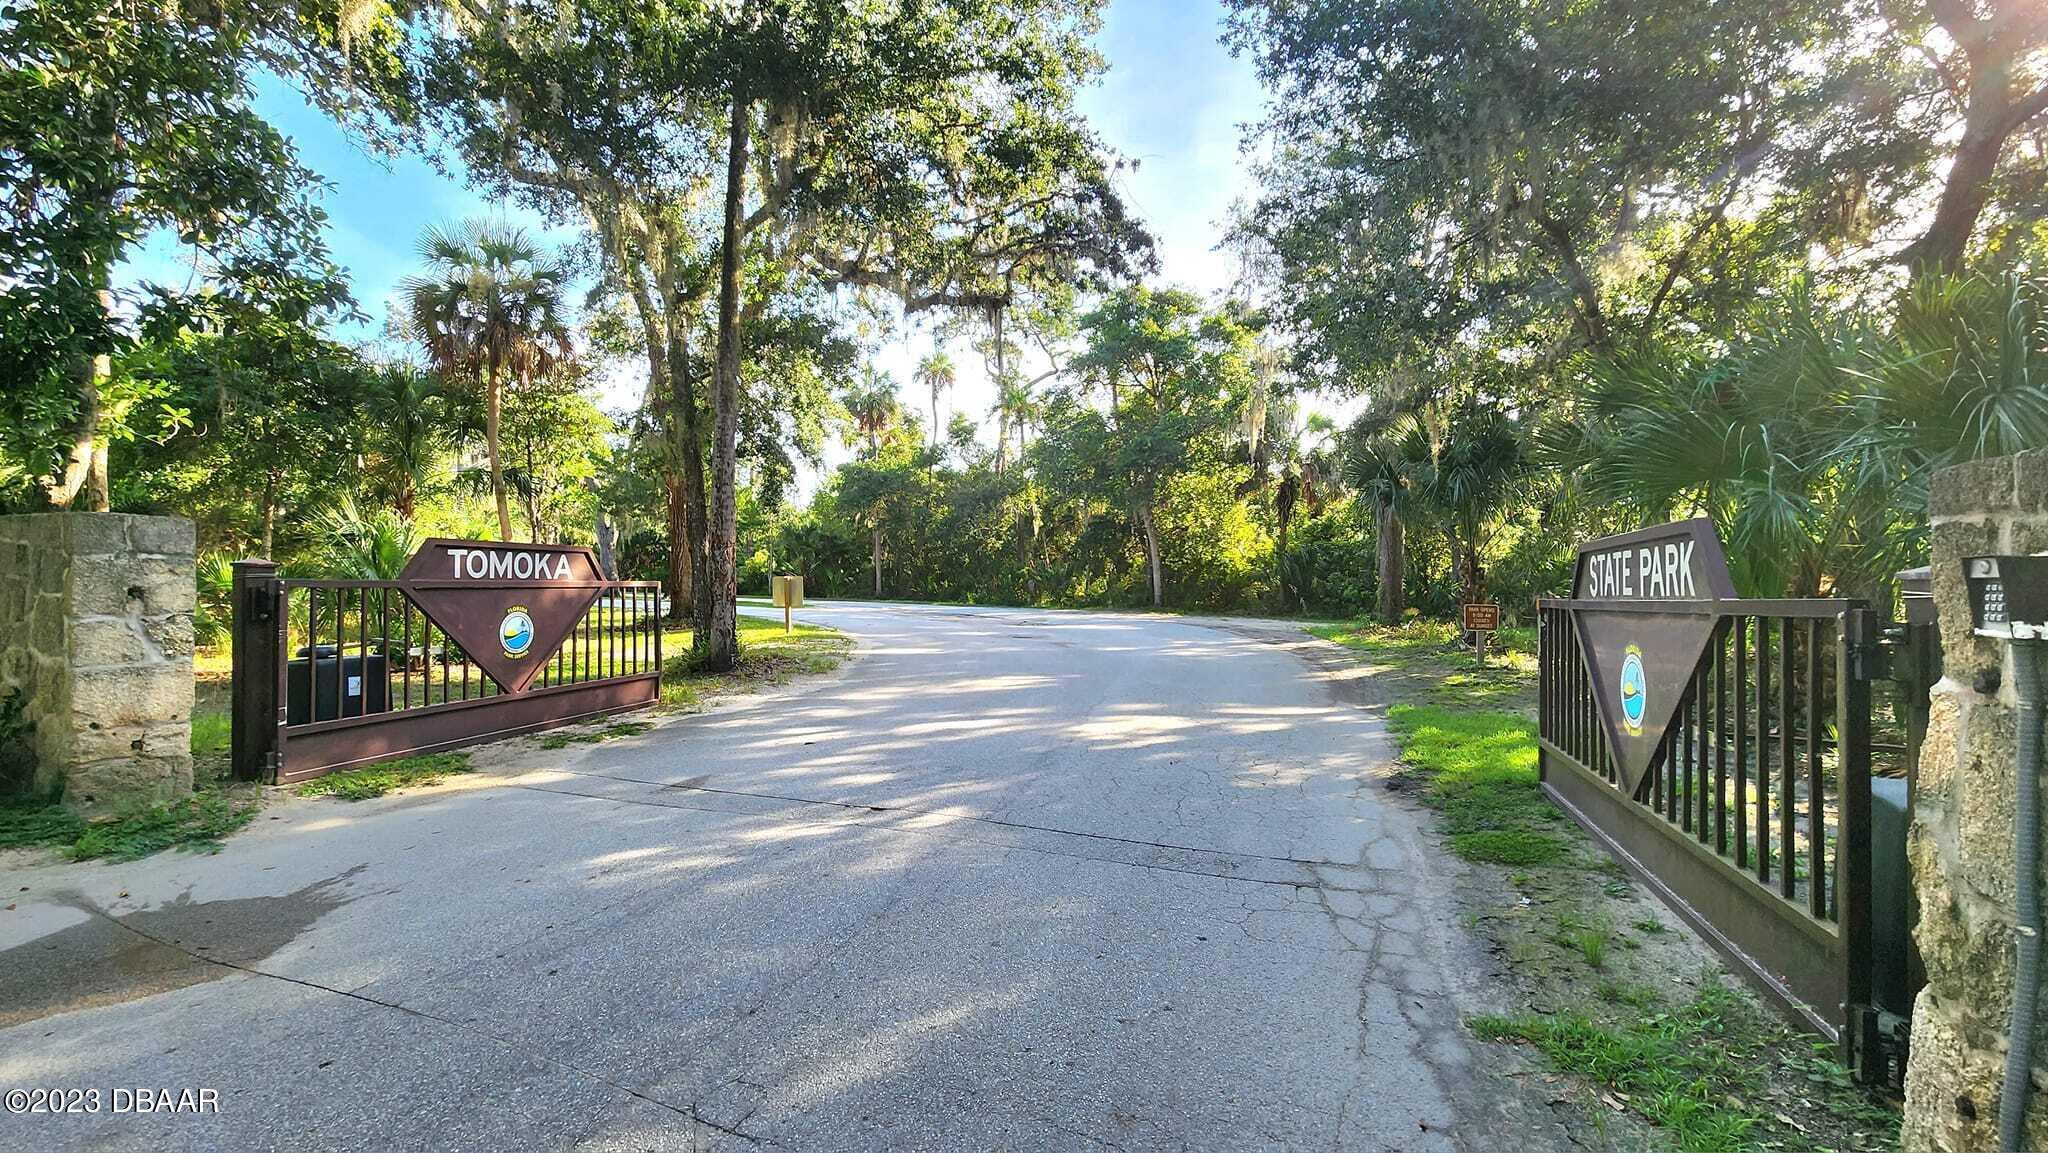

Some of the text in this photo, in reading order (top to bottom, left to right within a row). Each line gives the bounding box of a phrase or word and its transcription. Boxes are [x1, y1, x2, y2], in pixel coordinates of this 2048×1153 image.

[447, 549, 574, 580] TOMOKA
[1589, 540, 1696, 598] STATE PARK
